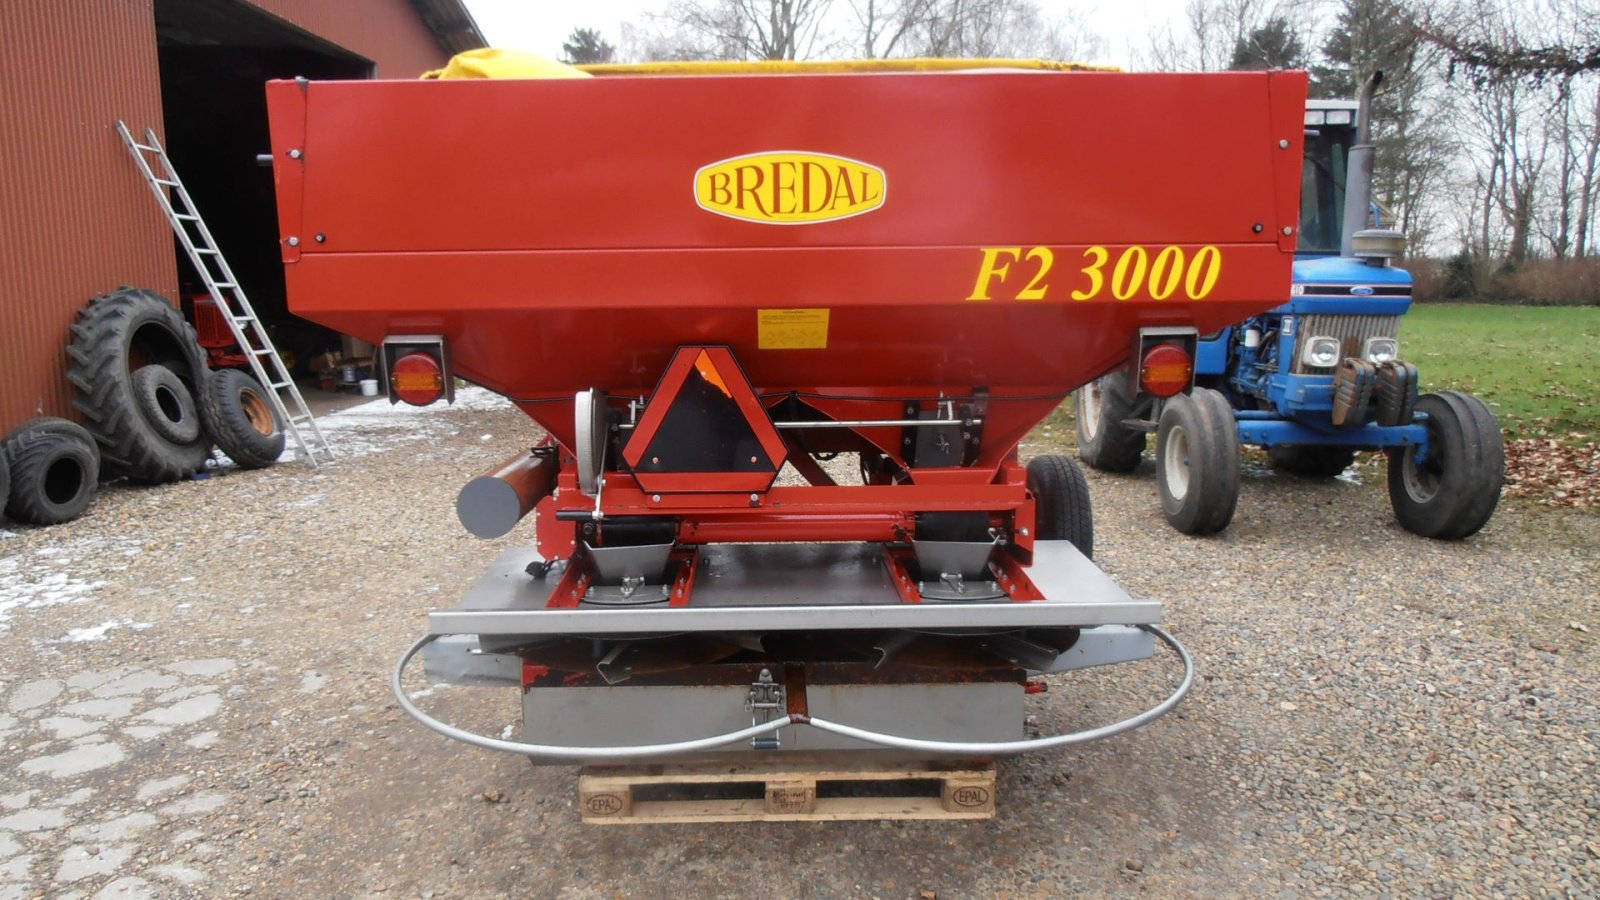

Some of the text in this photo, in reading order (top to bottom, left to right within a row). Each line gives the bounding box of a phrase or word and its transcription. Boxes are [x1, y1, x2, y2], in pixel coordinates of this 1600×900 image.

[708, 161, 879, 217] BREDAL
[965, 245, 1221, 301] F2 3000
[959, 790, 983, 802] EPAL
